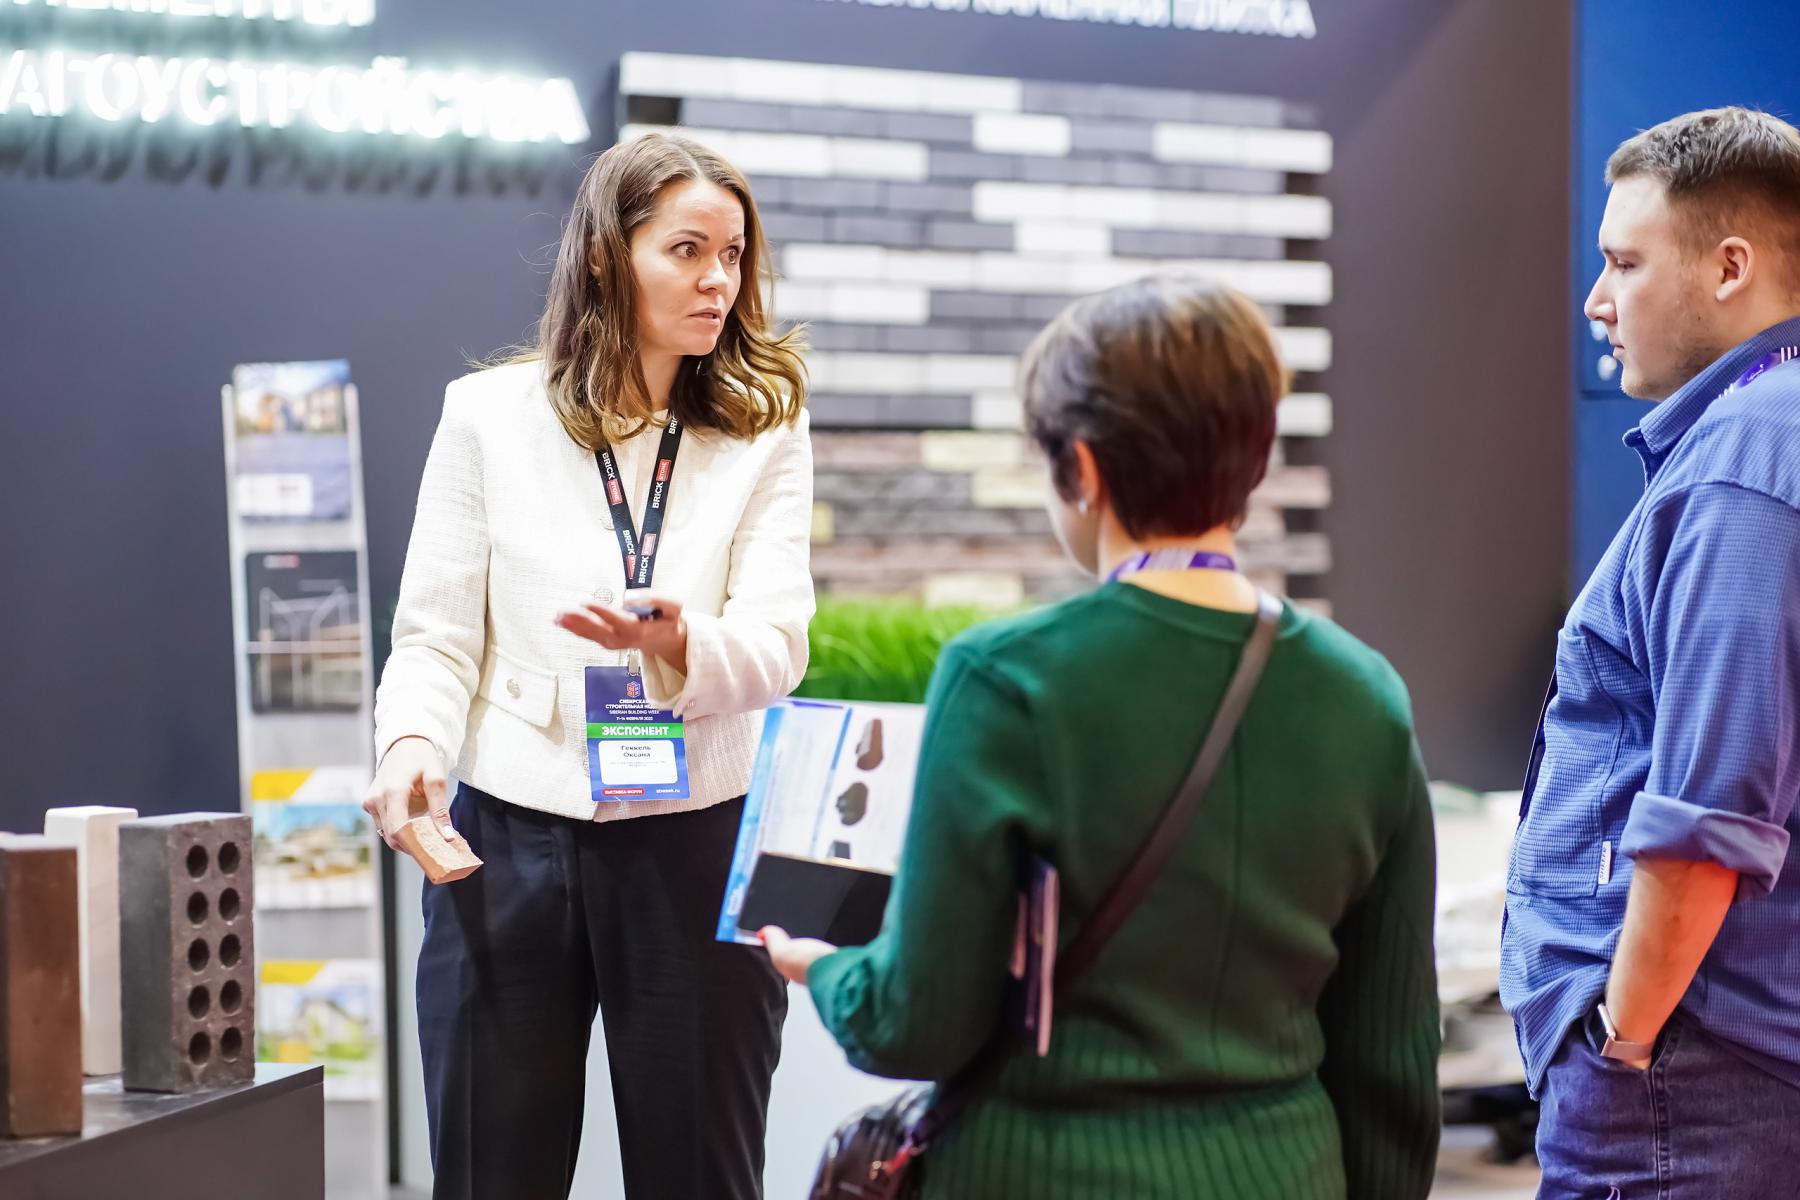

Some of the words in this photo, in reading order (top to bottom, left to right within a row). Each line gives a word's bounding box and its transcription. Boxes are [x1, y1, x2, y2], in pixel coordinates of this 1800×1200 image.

[602, 452, 616, 480] BRICK
[652, 481, 663, 509] BRICK
[622, 529, 635, 555] BRICK
[638, 556, 649, 584] BRICK
[601, 726, 669, 736] ЭКСПОНЕНТ
